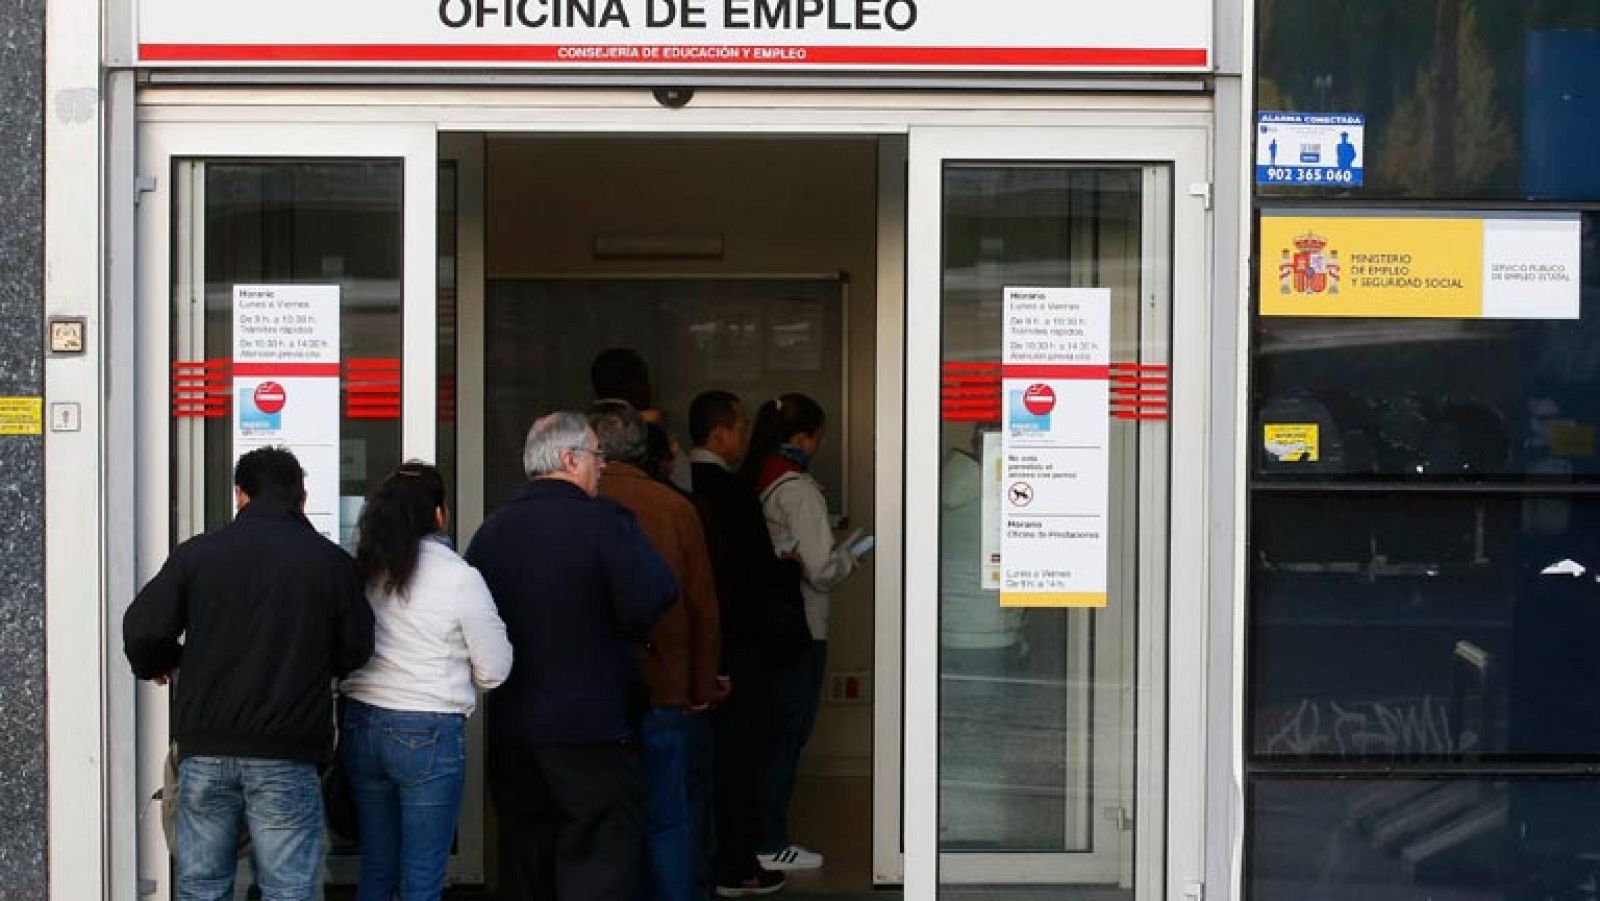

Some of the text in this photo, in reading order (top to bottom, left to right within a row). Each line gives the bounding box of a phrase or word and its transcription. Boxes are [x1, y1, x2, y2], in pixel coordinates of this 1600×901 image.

[438, 0, 919, 31] OFICINA DE EMPLEO
[557, 46, 807, 61] CONSEJERÍA DE EDUCACIÓN Y EMPLEO
[1267, 168, 1353, 182] 902 365 060
[1351, 254, 1412, 264] MINISTERIO
[1351, 266, 1409, 276] DE EMPLEO
[1350, 277, 1465, 289] Y SEGURIDAD SOCIAL
